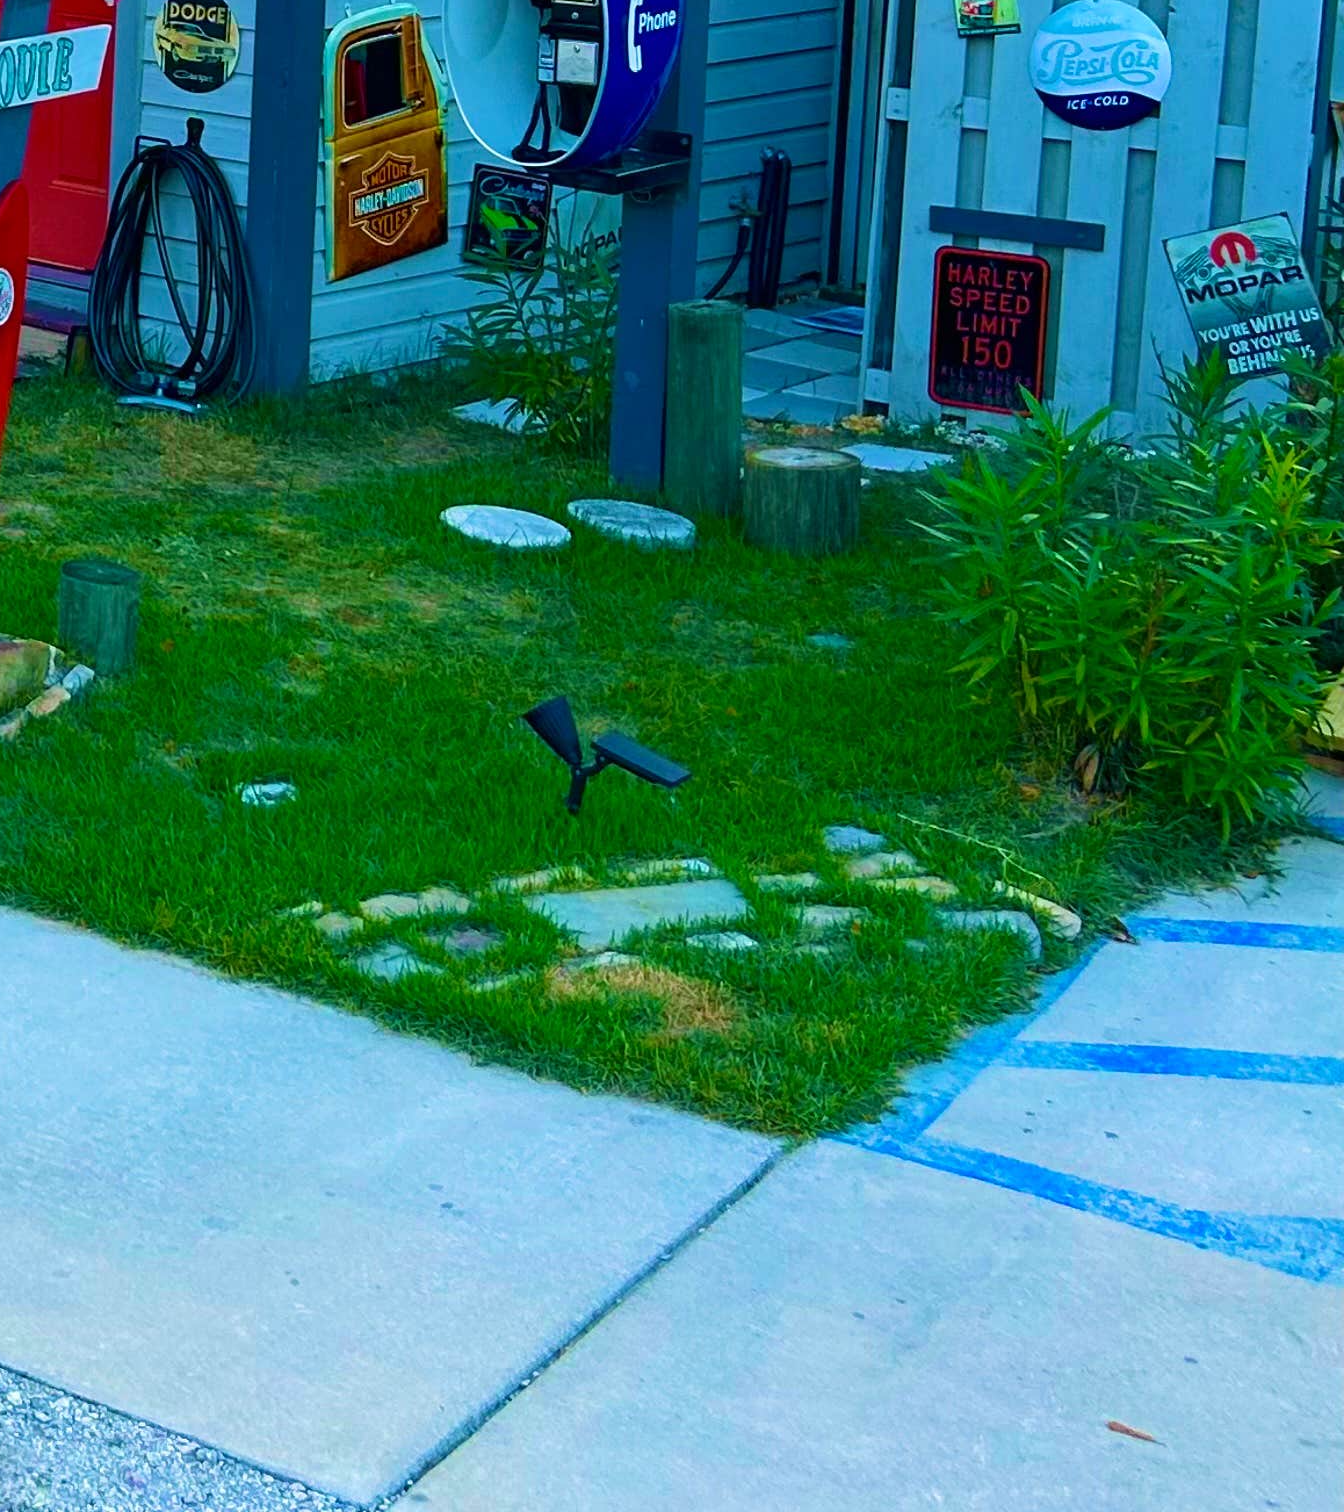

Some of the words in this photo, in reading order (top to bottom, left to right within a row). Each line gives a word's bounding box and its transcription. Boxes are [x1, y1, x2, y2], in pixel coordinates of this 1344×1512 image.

[168, 1, 226, 25] DODGE
[638, 9, 677, 34] Phone
[370, 163, 408, 186] MOTOR
[370, 208, 409, 237] CYCLES
[947, 263, 1034, 292] HARLEY
[1184, 265, 1305, 304] MOPAR
[949, 287, 1030, 315] SPEED
[956, 311, 1022, 338] LIMIT
[1199, 322, 1250, 343] YOU'RE
[1249, 310, 1298, 334] WITH
[1298, 307, 1320, 322] US
[962, 336, 1013, 370] 150
[1228, 339, 1251, 355] OR
[1251, 329, 1303, 352] YOU'RE
[1227, 347, 1291, 375] BEHIN
